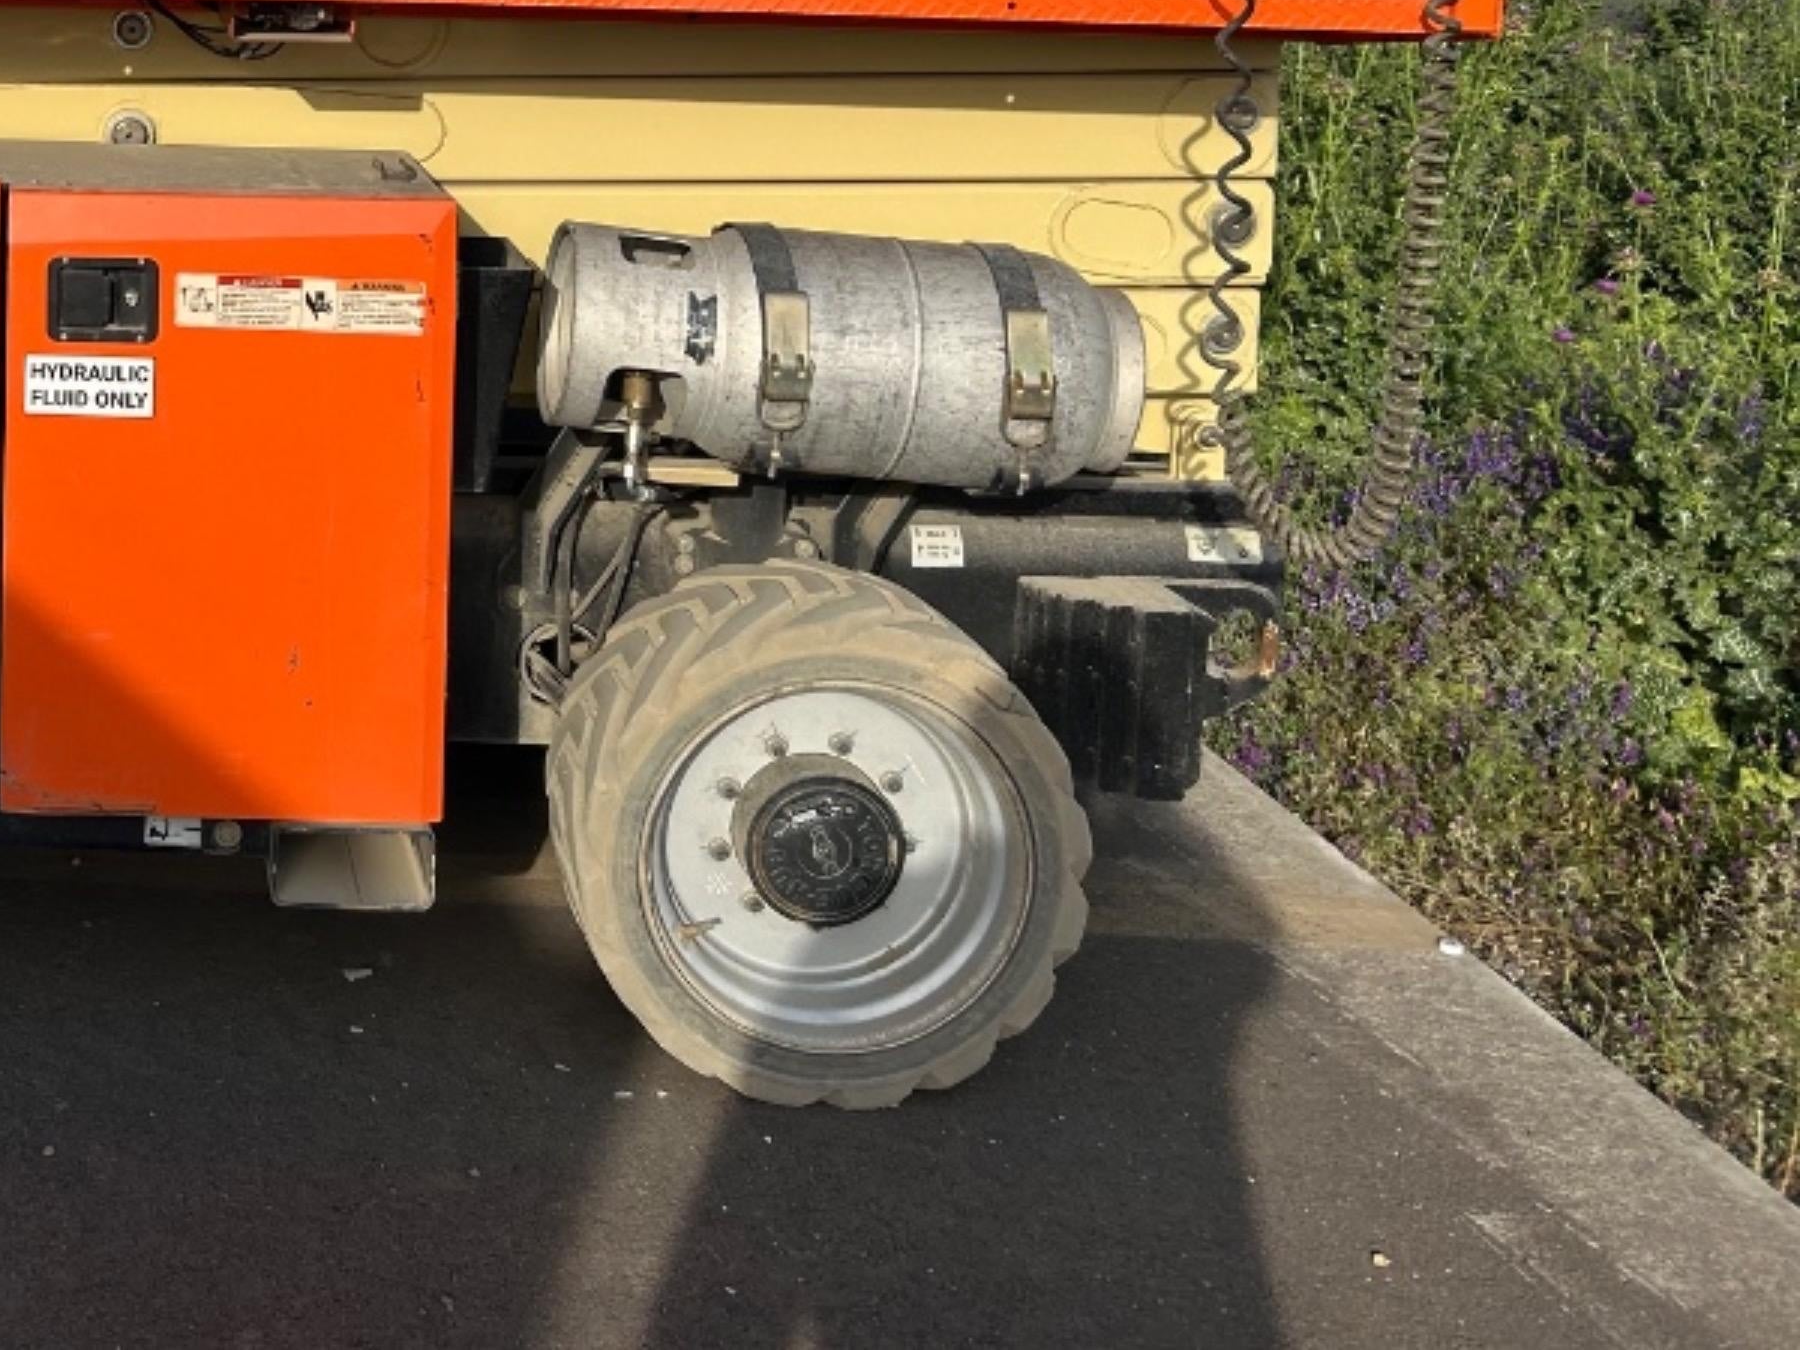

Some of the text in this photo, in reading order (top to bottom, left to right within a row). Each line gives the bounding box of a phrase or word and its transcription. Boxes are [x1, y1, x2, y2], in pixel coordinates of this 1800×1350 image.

[30, 362, 149, 382] HYDRAULIC
[30, 389, 148, 409] FLUID ONLY
